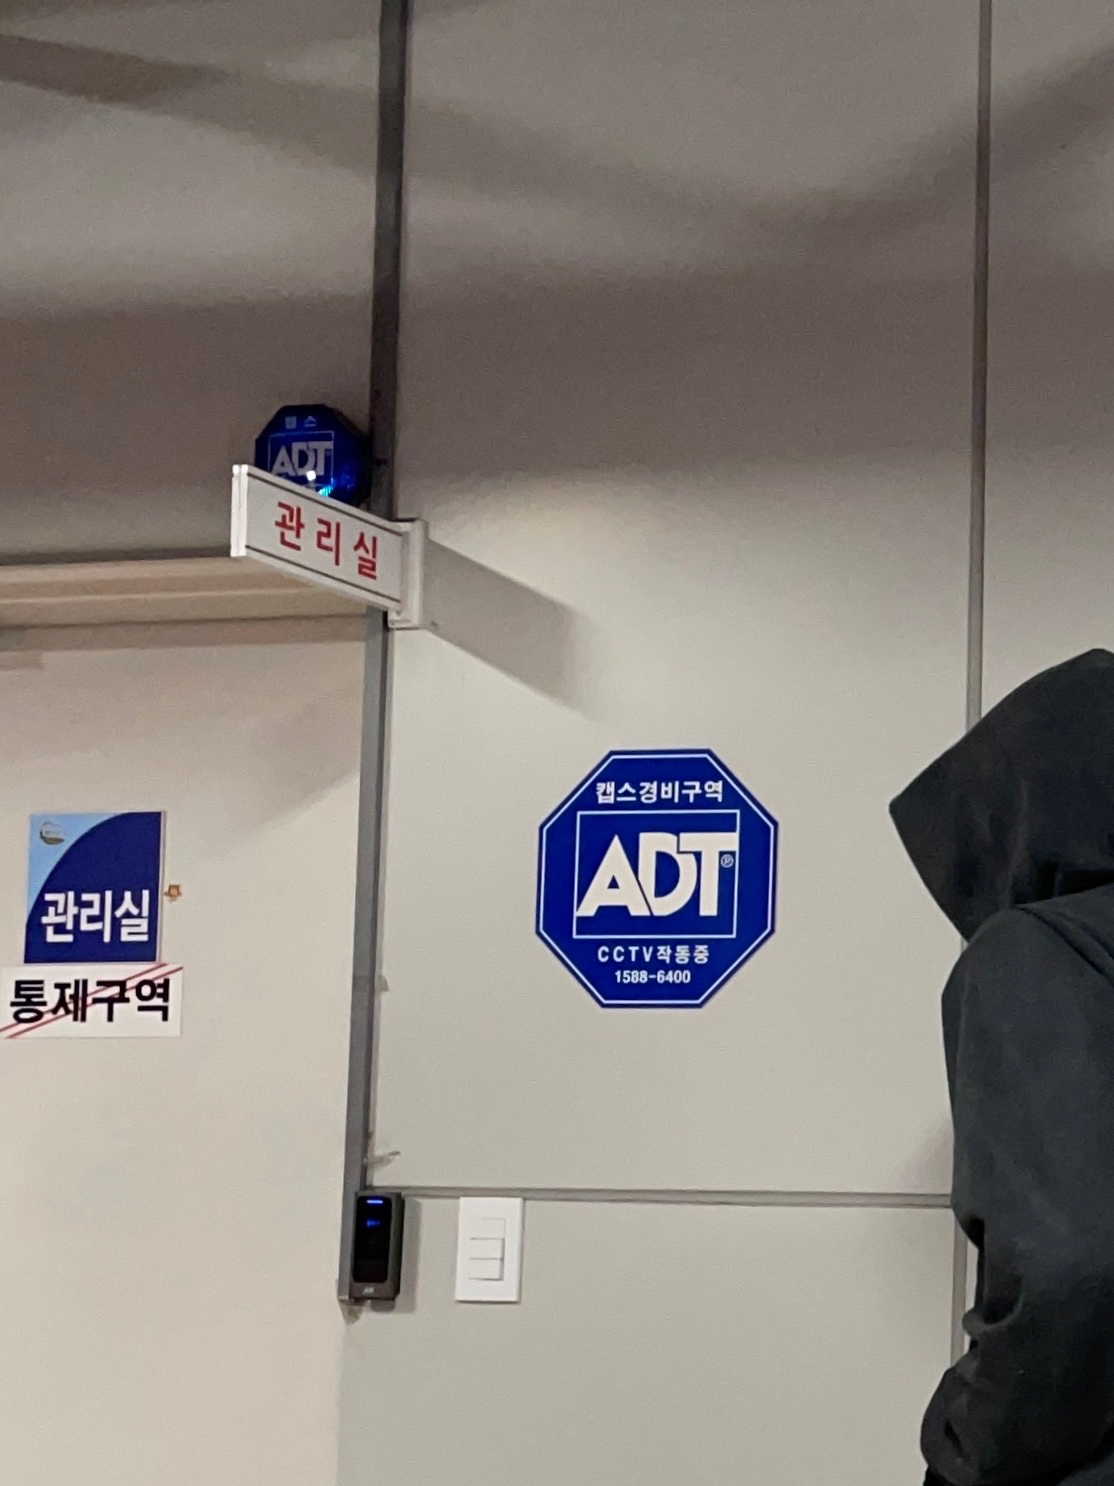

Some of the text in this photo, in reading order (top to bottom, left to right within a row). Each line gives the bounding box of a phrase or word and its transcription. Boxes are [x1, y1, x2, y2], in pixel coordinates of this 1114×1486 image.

[270, 440, 333, 477] ADT
[275, 501, 377, 580] 관리실
[575, 832, 739, 917] ADT
[41, 889, 150, 943] 관리실
[10, 977, 170, 1024] 통제구역
[614, 969, 692, 984] 1588-6400
